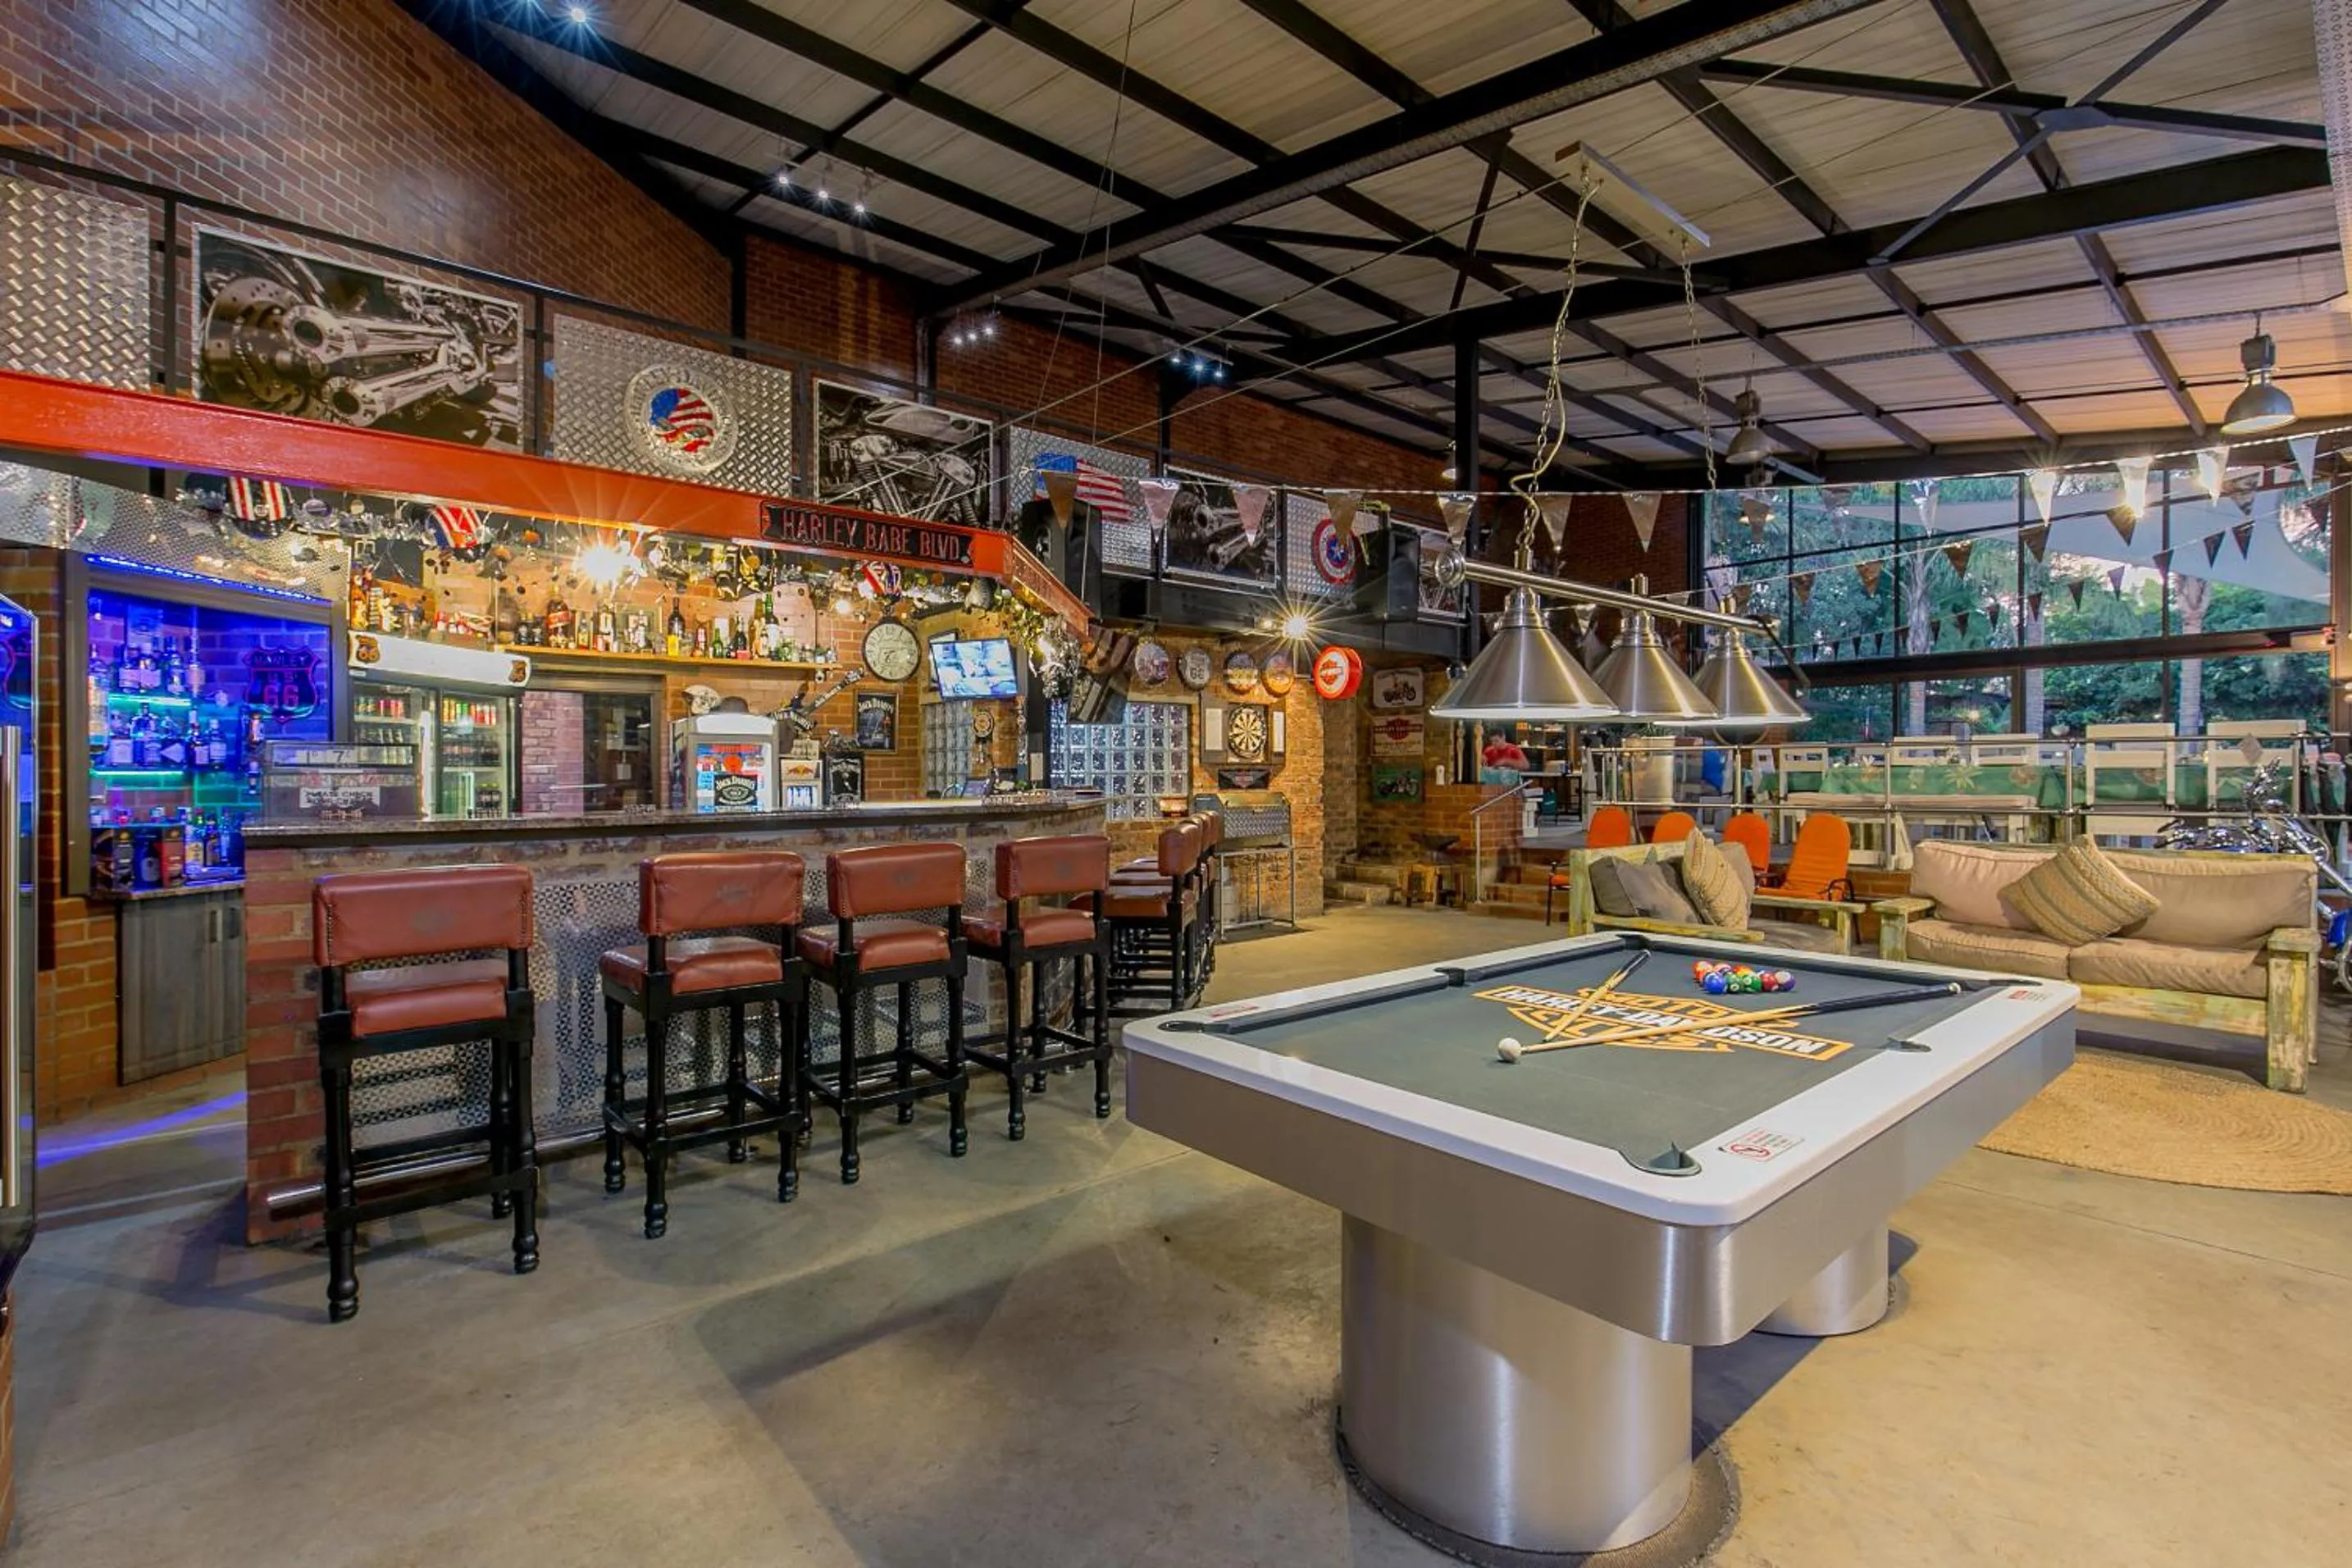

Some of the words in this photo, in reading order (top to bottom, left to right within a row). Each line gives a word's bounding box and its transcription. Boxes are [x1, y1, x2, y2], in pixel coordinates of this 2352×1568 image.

[782, 507, 858, 549] HARLEY
[865, 522, 913, 555] BABE
[263, 684, 300, 710] 66
[1493, 988, 1827, 1054] HARLY-DADSON
